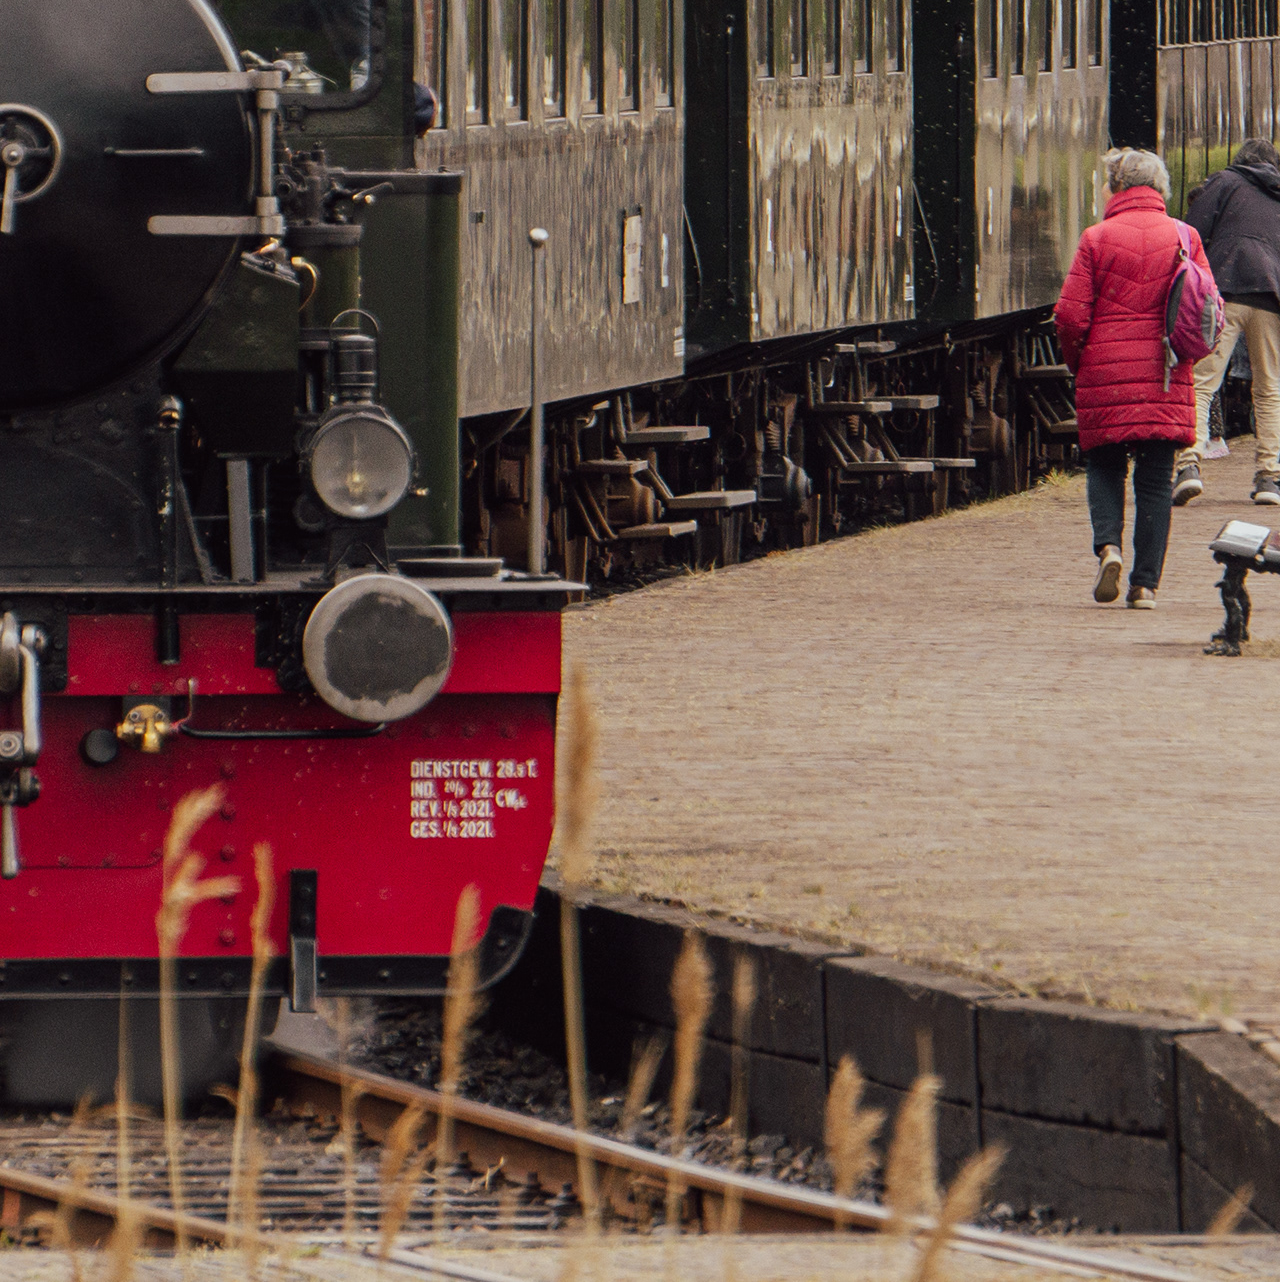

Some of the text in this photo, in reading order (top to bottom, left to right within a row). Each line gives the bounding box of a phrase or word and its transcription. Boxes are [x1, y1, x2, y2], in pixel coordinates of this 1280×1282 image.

[410, 759, 493, 778] DIENSTGEW.
[410, 779, 438, 798] IND.
[410, 799, 443, 818] REV.
[410, 819, 443, 838] GES.
